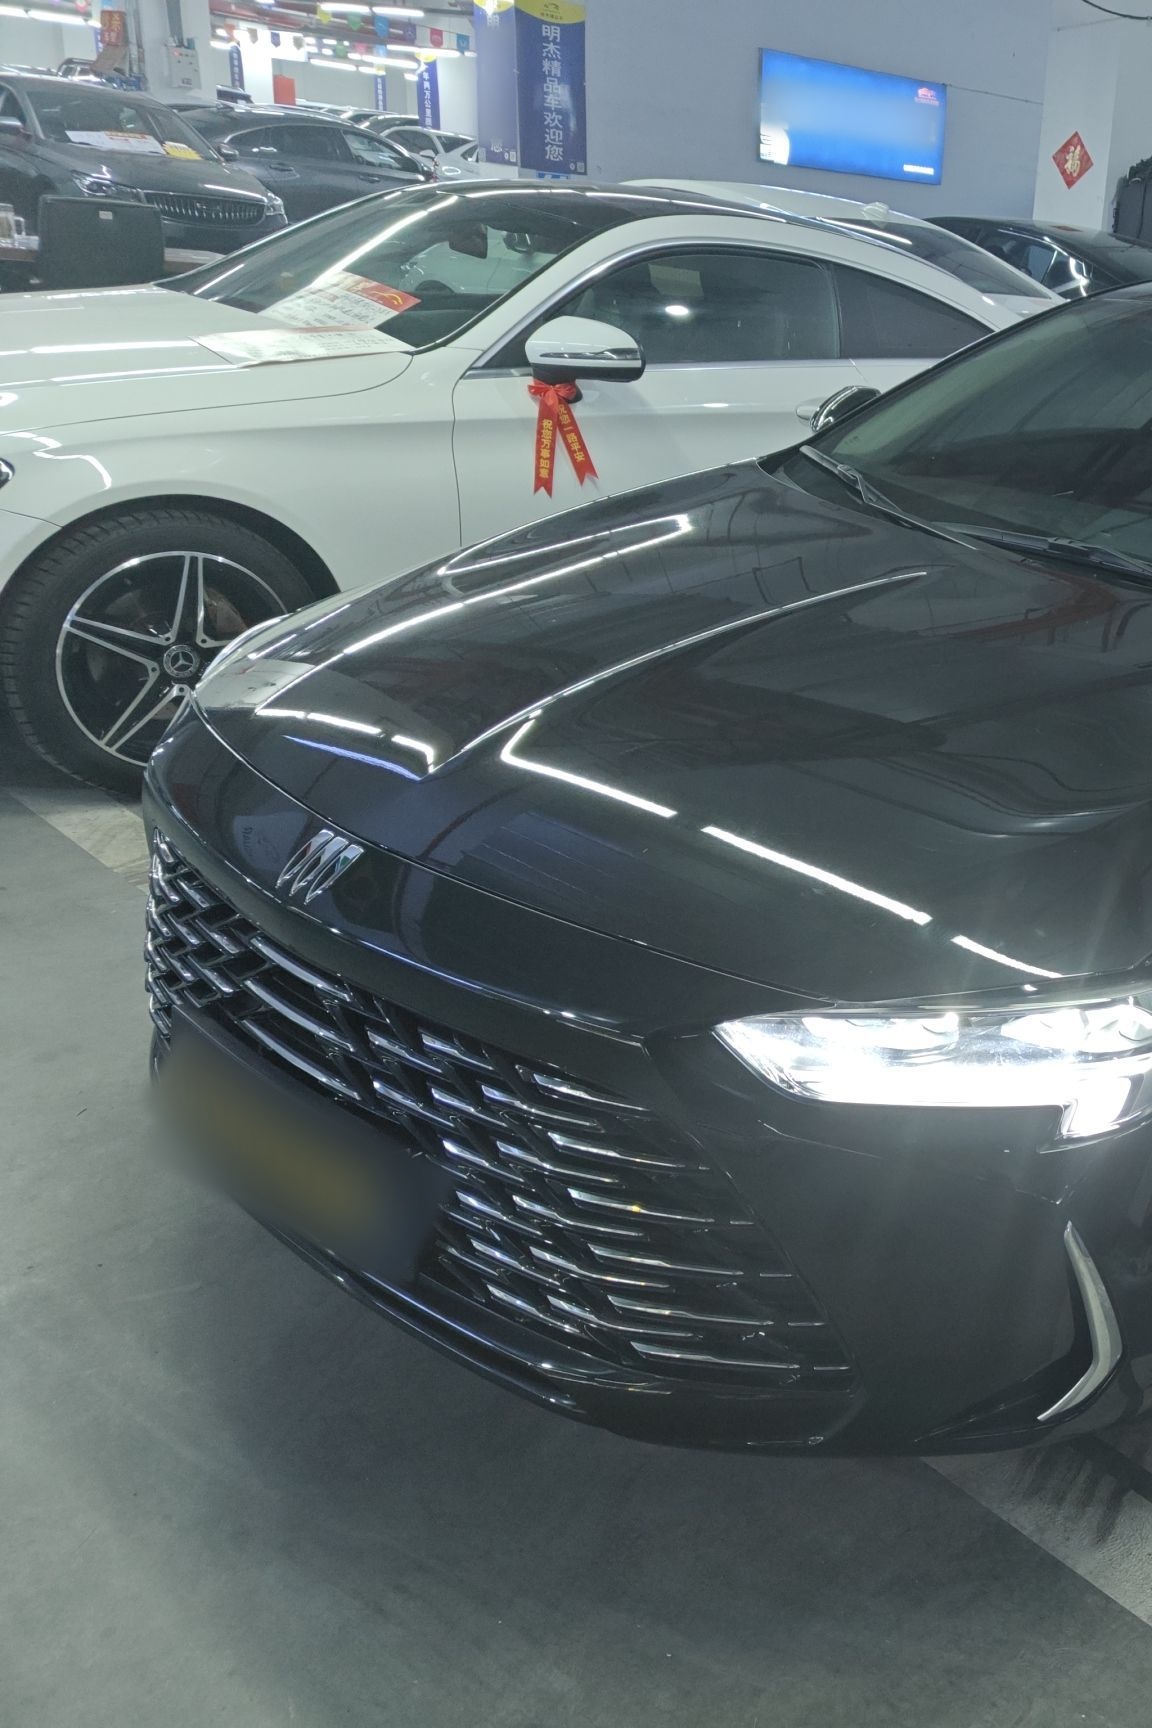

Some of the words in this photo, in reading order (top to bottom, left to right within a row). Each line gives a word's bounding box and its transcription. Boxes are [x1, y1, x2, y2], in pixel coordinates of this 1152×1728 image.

[541, 23, 564, 162] 明杰精品车欢迎您
[1065, 144, 1081, 177] 福
[539, 418, 553, 478] 祝您万事如意
